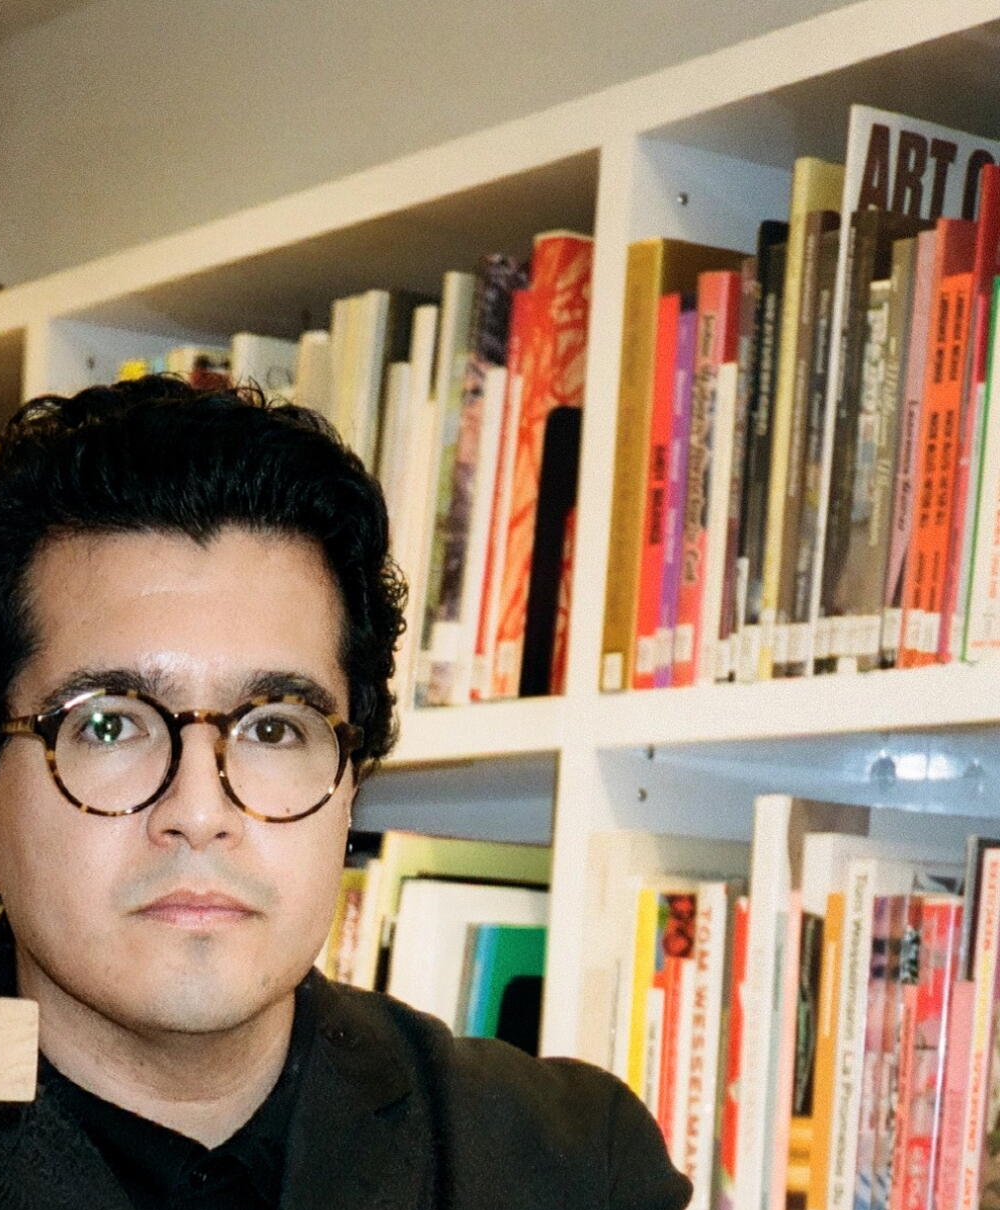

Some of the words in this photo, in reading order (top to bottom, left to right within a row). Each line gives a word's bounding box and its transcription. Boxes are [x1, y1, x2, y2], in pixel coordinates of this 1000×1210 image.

[858, 123, 958, 220] ART
[696, 906, 712, 971] TOM
[685, 985, 710, 1179] WESSELMAN
